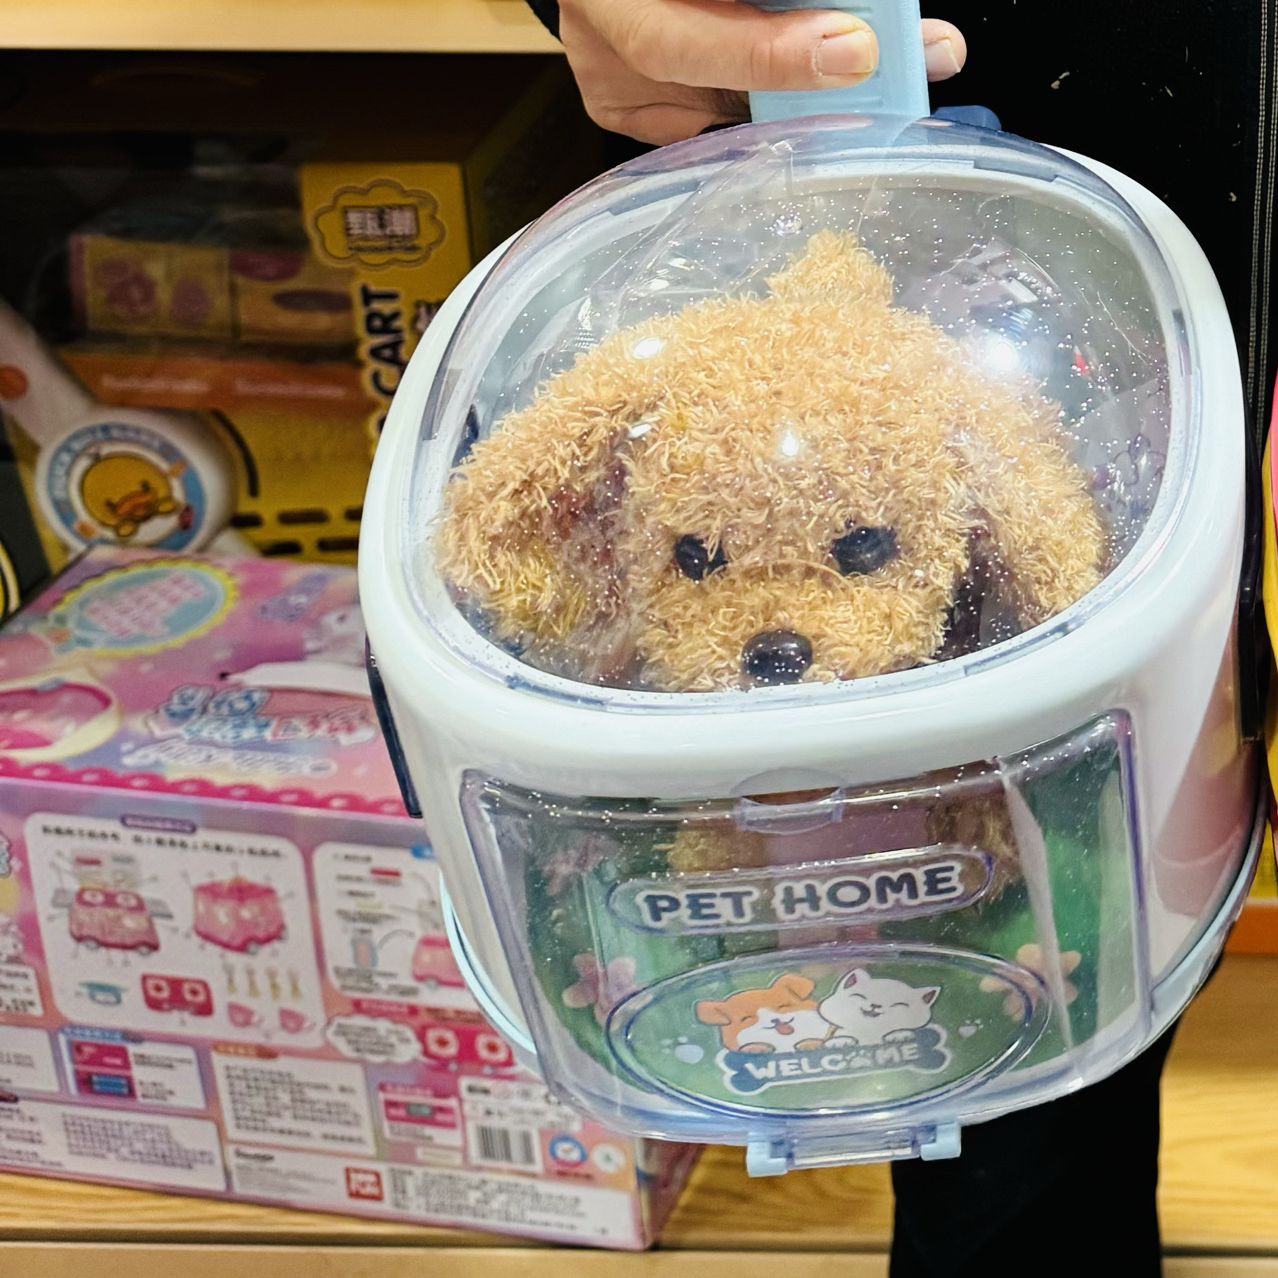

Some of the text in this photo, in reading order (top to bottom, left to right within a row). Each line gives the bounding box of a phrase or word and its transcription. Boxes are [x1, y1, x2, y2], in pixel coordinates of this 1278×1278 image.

[361, 284, 406, 397] CART
[645, 863, 961, 923] PET HOME
[745, 1044, 921, 1078] WELCOME
